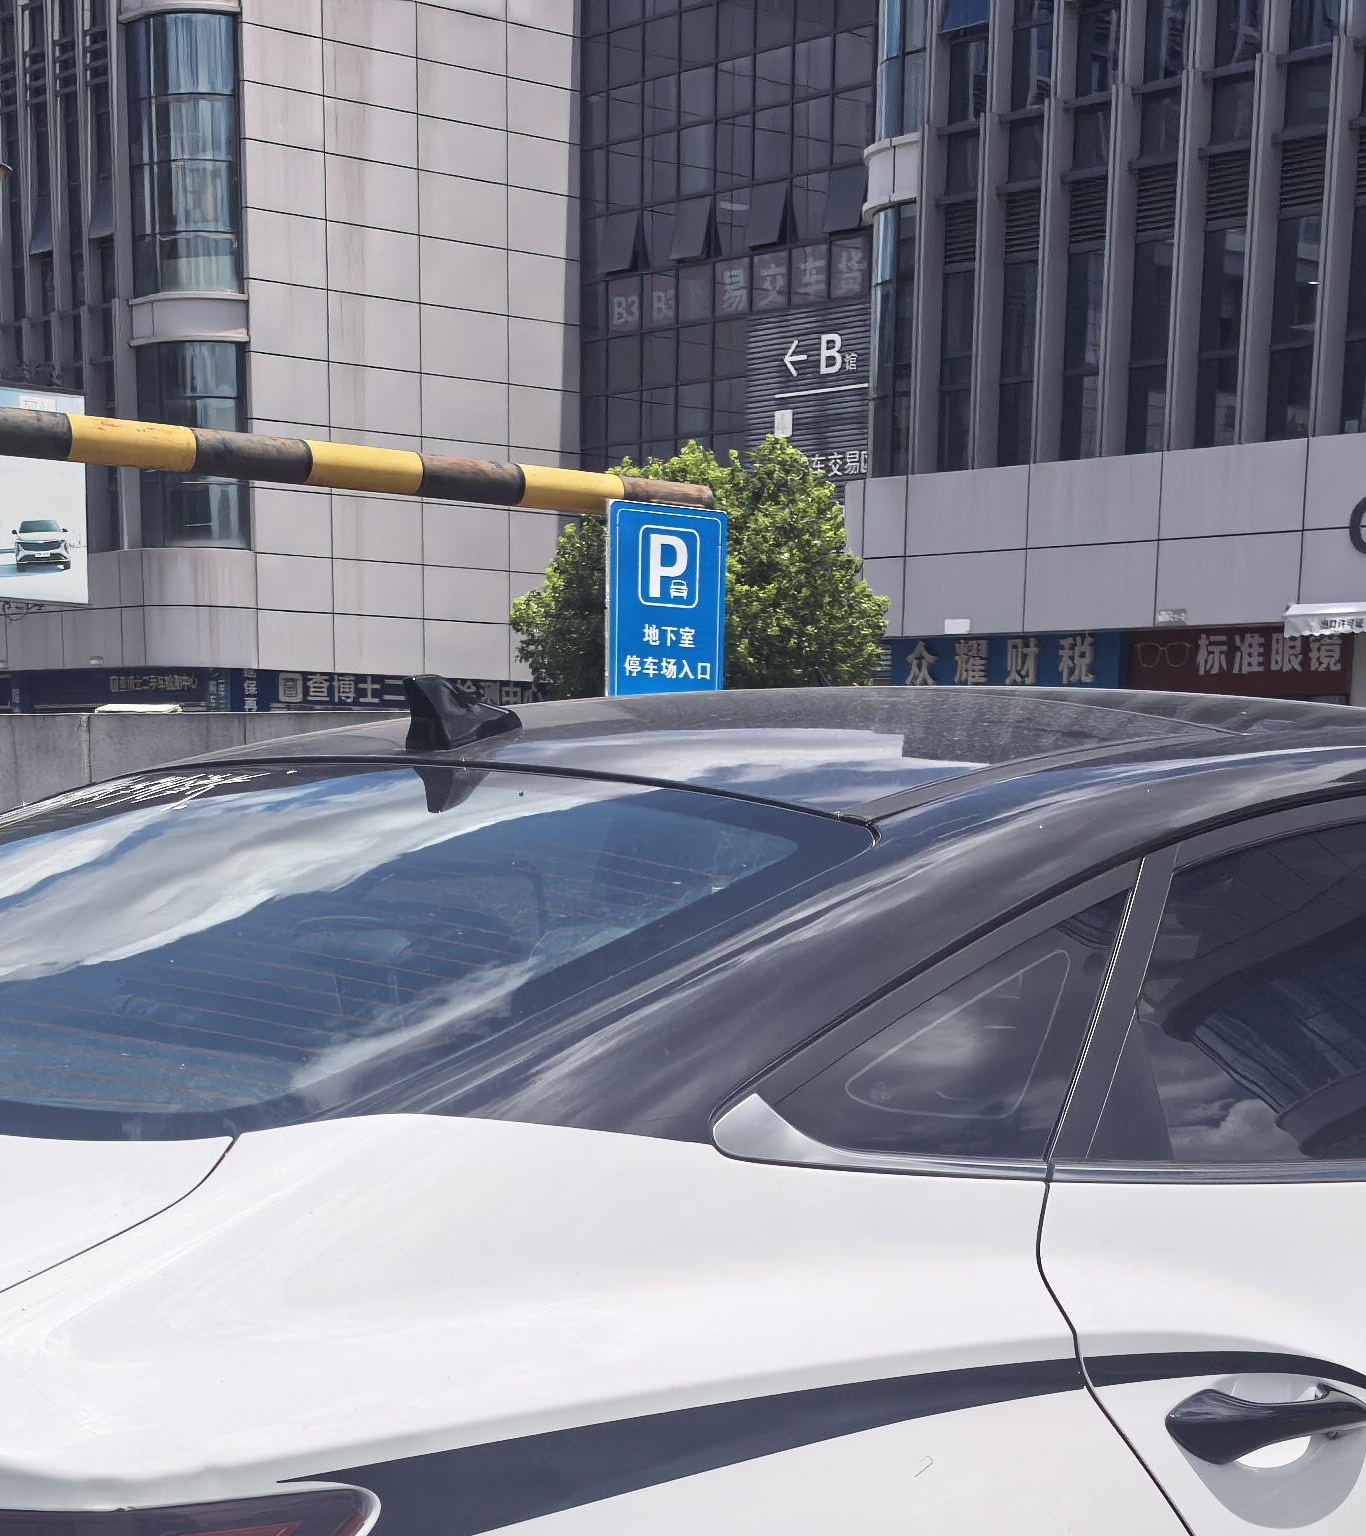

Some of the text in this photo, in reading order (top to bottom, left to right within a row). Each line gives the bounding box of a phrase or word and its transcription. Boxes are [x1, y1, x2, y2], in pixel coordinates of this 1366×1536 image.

[649, 533, 688, 598] P
[643, 624, 695, 648] 地下室
[1196, 632, 1342, 676] 标准眼镜
[624, 655, 711, 680] 停车场入口
[905, 633, 1096, 686] 众耀财税
